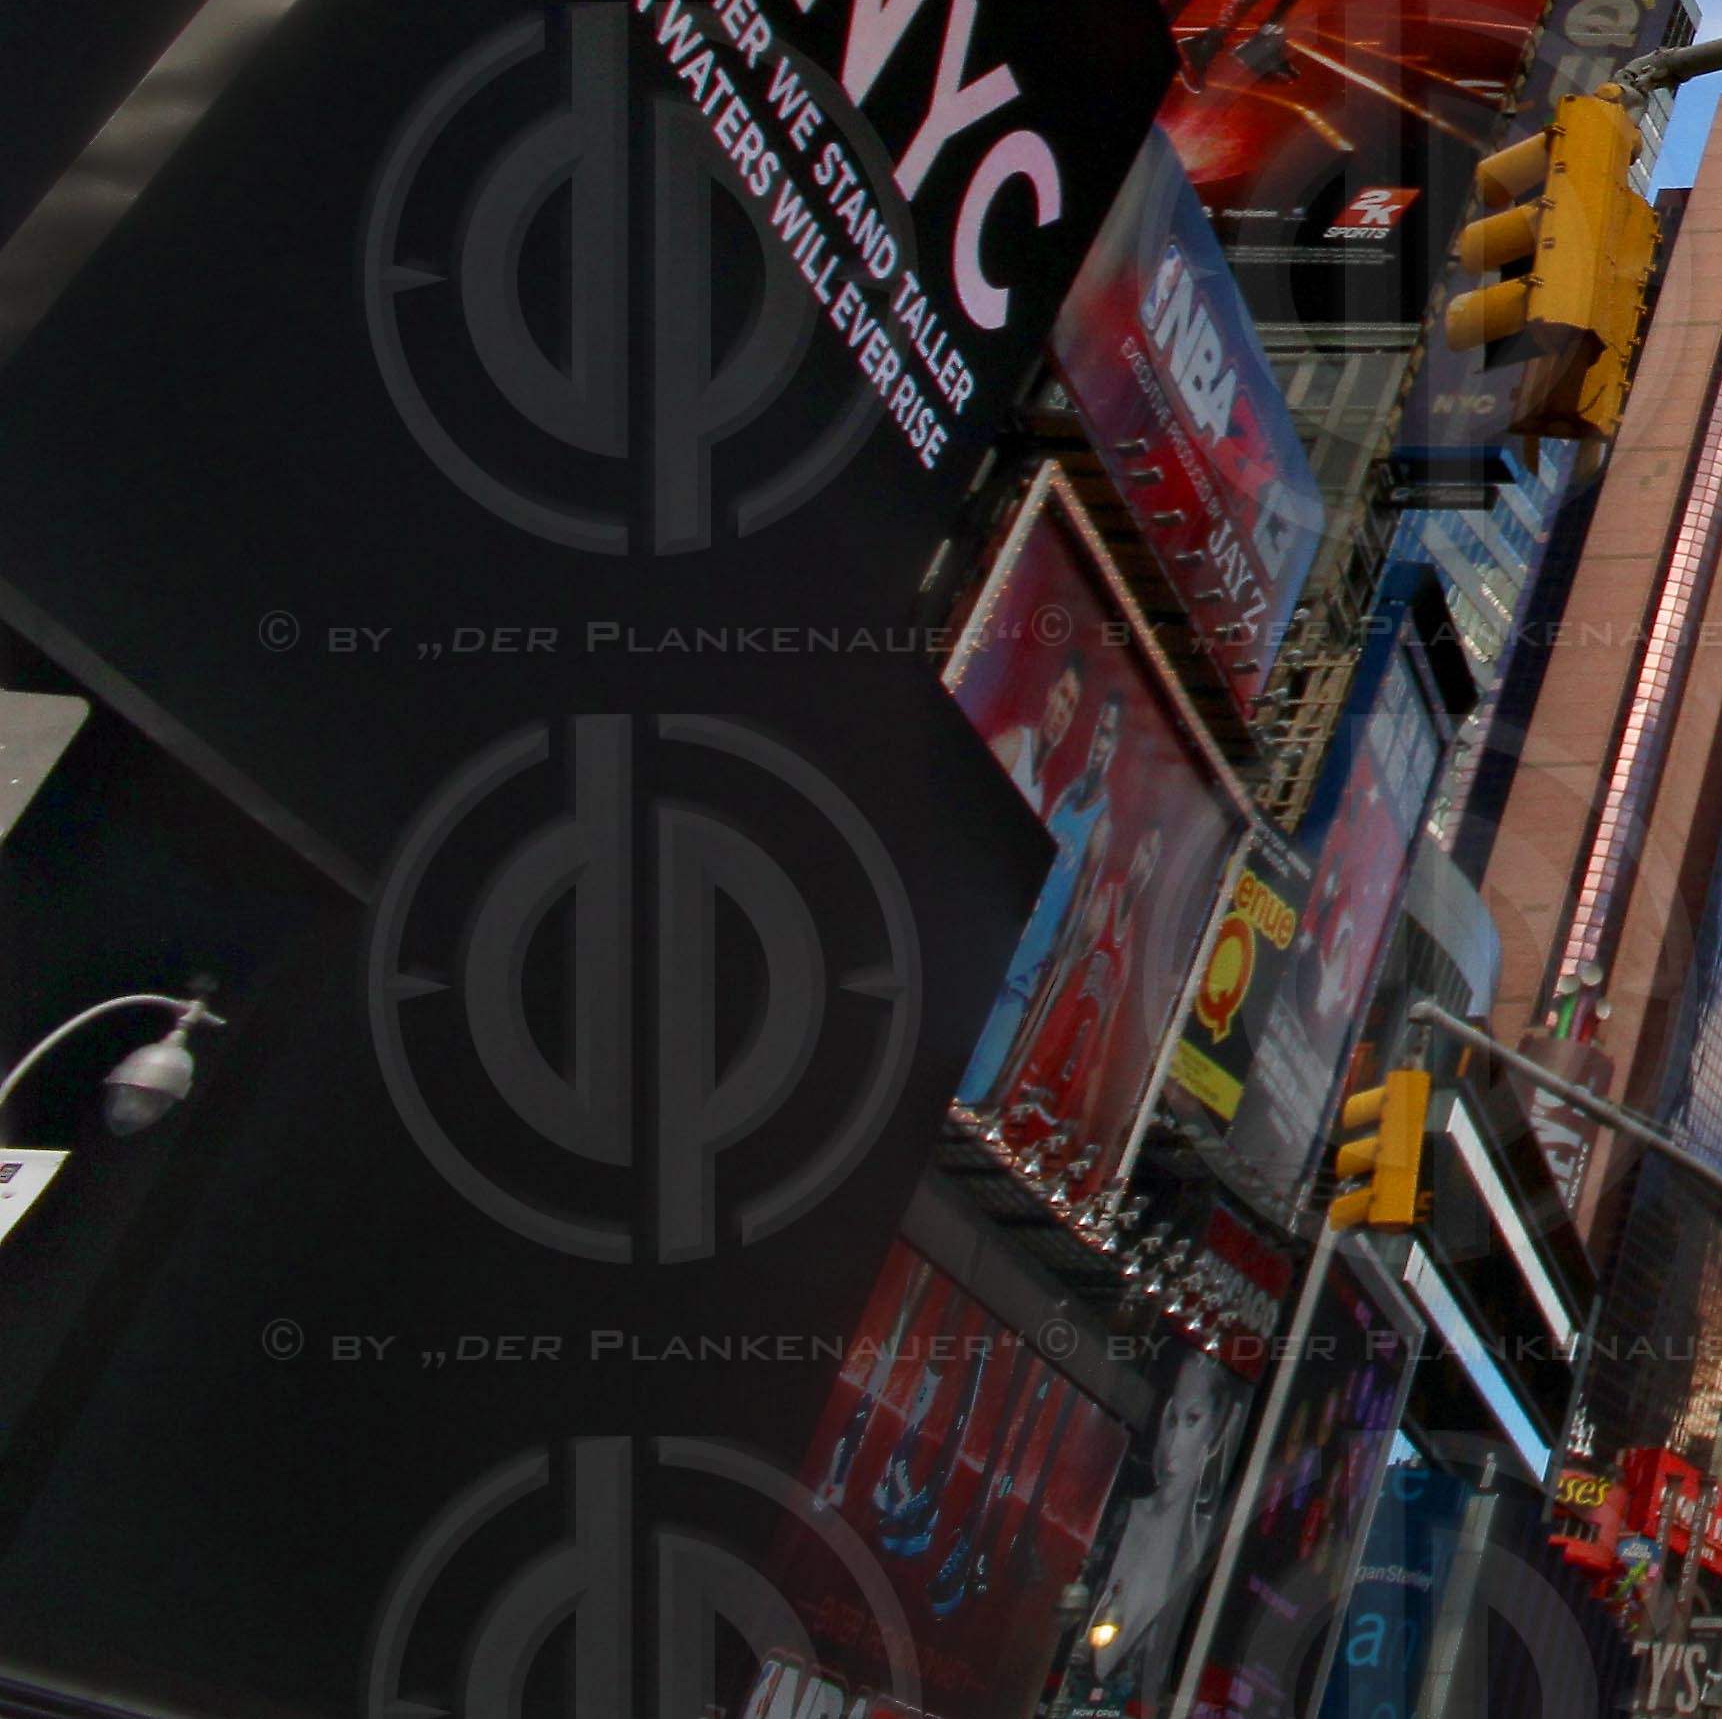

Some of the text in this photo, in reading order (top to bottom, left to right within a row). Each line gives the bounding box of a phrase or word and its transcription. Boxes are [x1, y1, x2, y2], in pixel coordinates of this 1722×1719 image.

[764, 55, 825, 154] WE
[813, 141, 897, 281] STAND
[889, 269, 977, 416] TALLER
[1323, 225, 1392, 240] SPORTS
[769, 178, 839, 304] WILL
[828, 282, 909, 403] EVER
[884, 376, 951, 472] RISE
[1430, 393, 1498, 415] NYC
[1195, 907, 1257, 1045] Q
